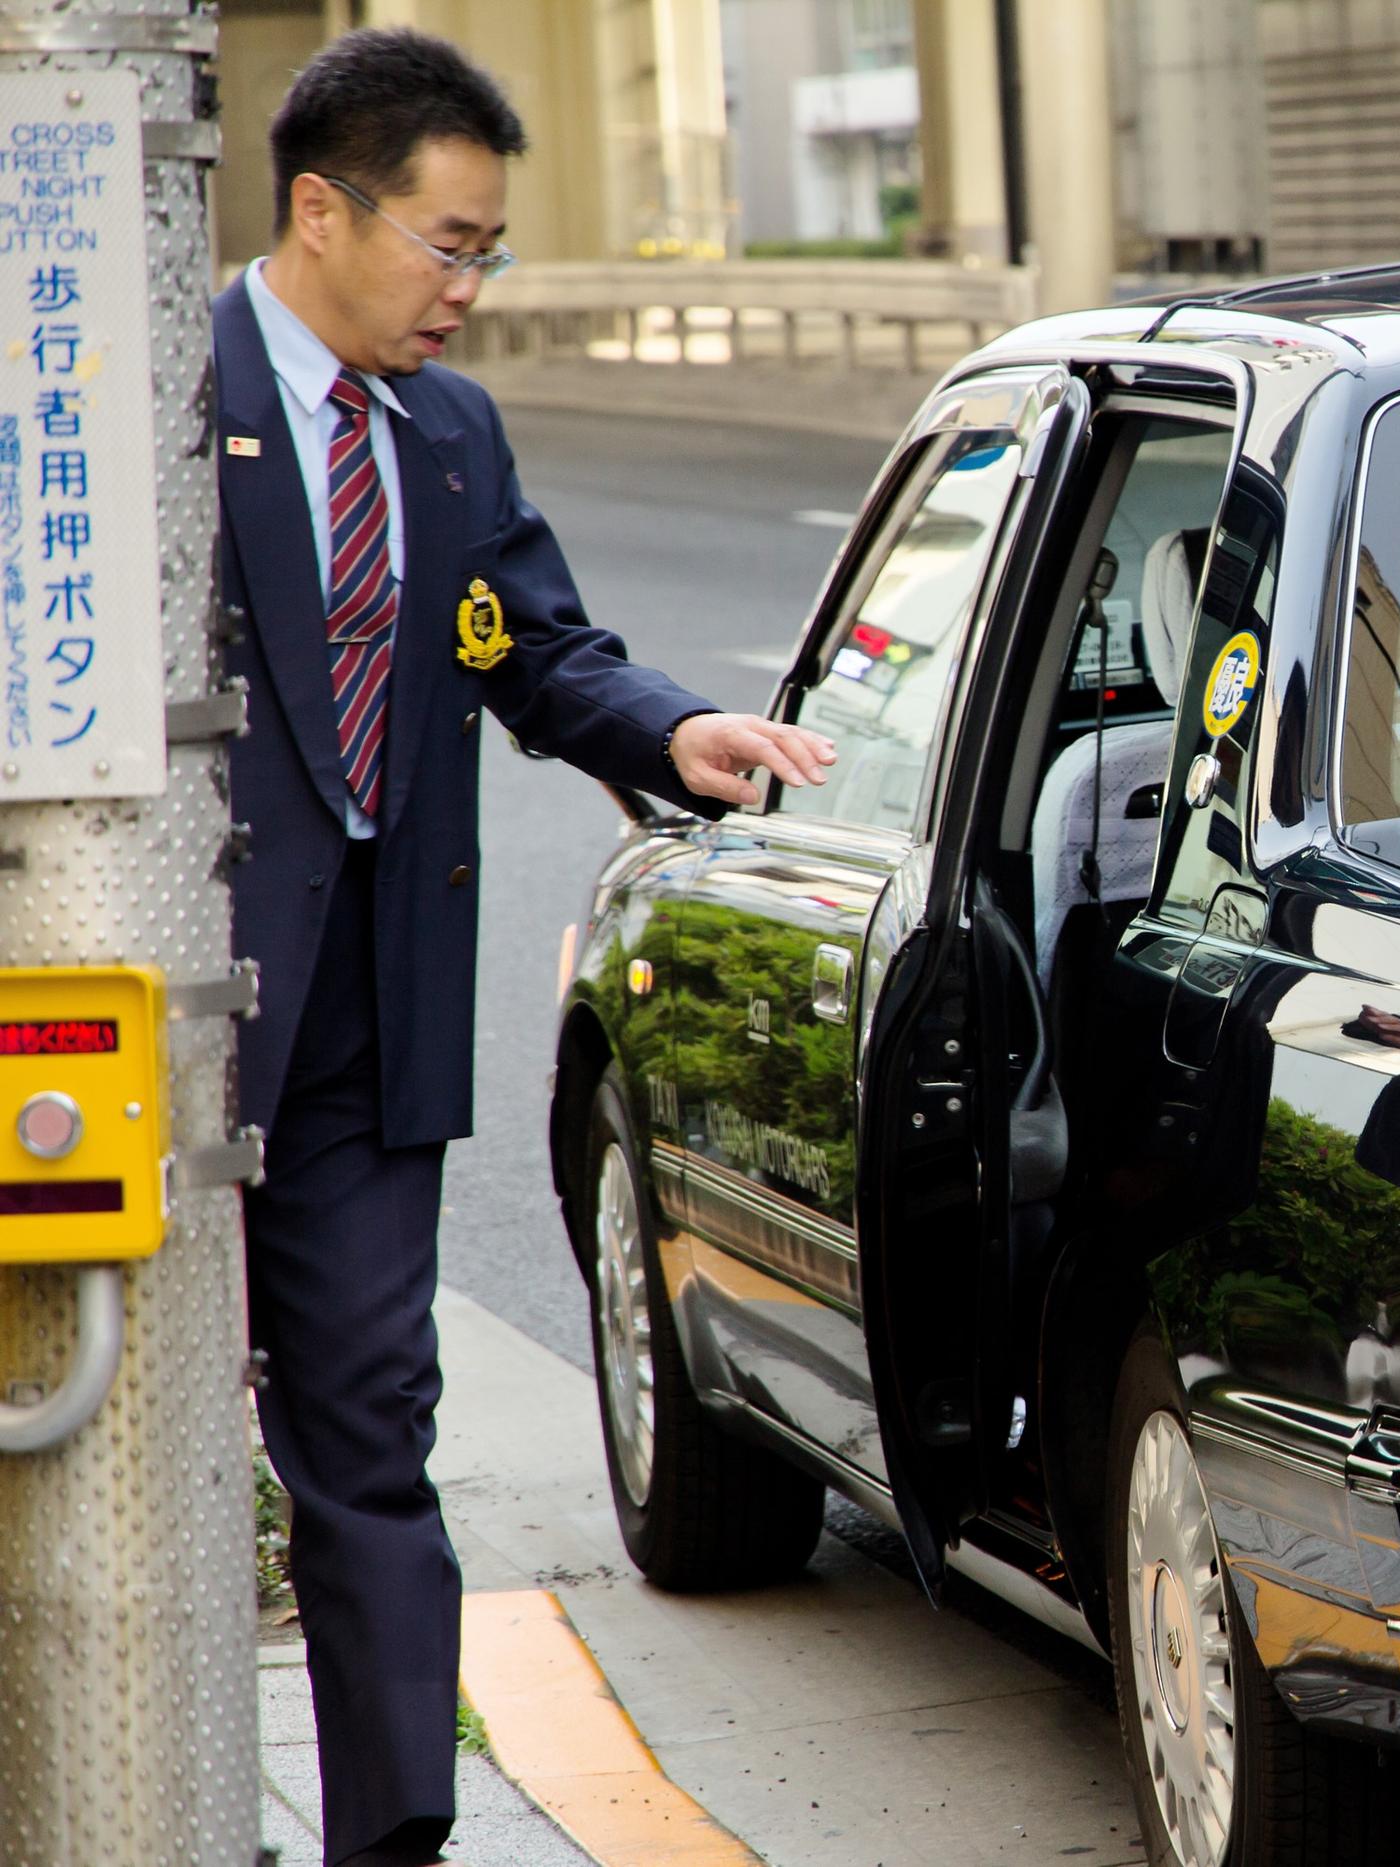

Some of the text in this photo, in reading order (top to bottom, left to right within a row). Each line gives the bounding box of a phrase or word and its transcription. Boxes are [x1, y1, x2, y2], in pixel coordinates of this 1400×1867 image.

[11, 122, 115, 147] CROSS
[22, 176, 106, 198] NIGHT
[30, 264, 97, 747] 歩行者用押ボタン
